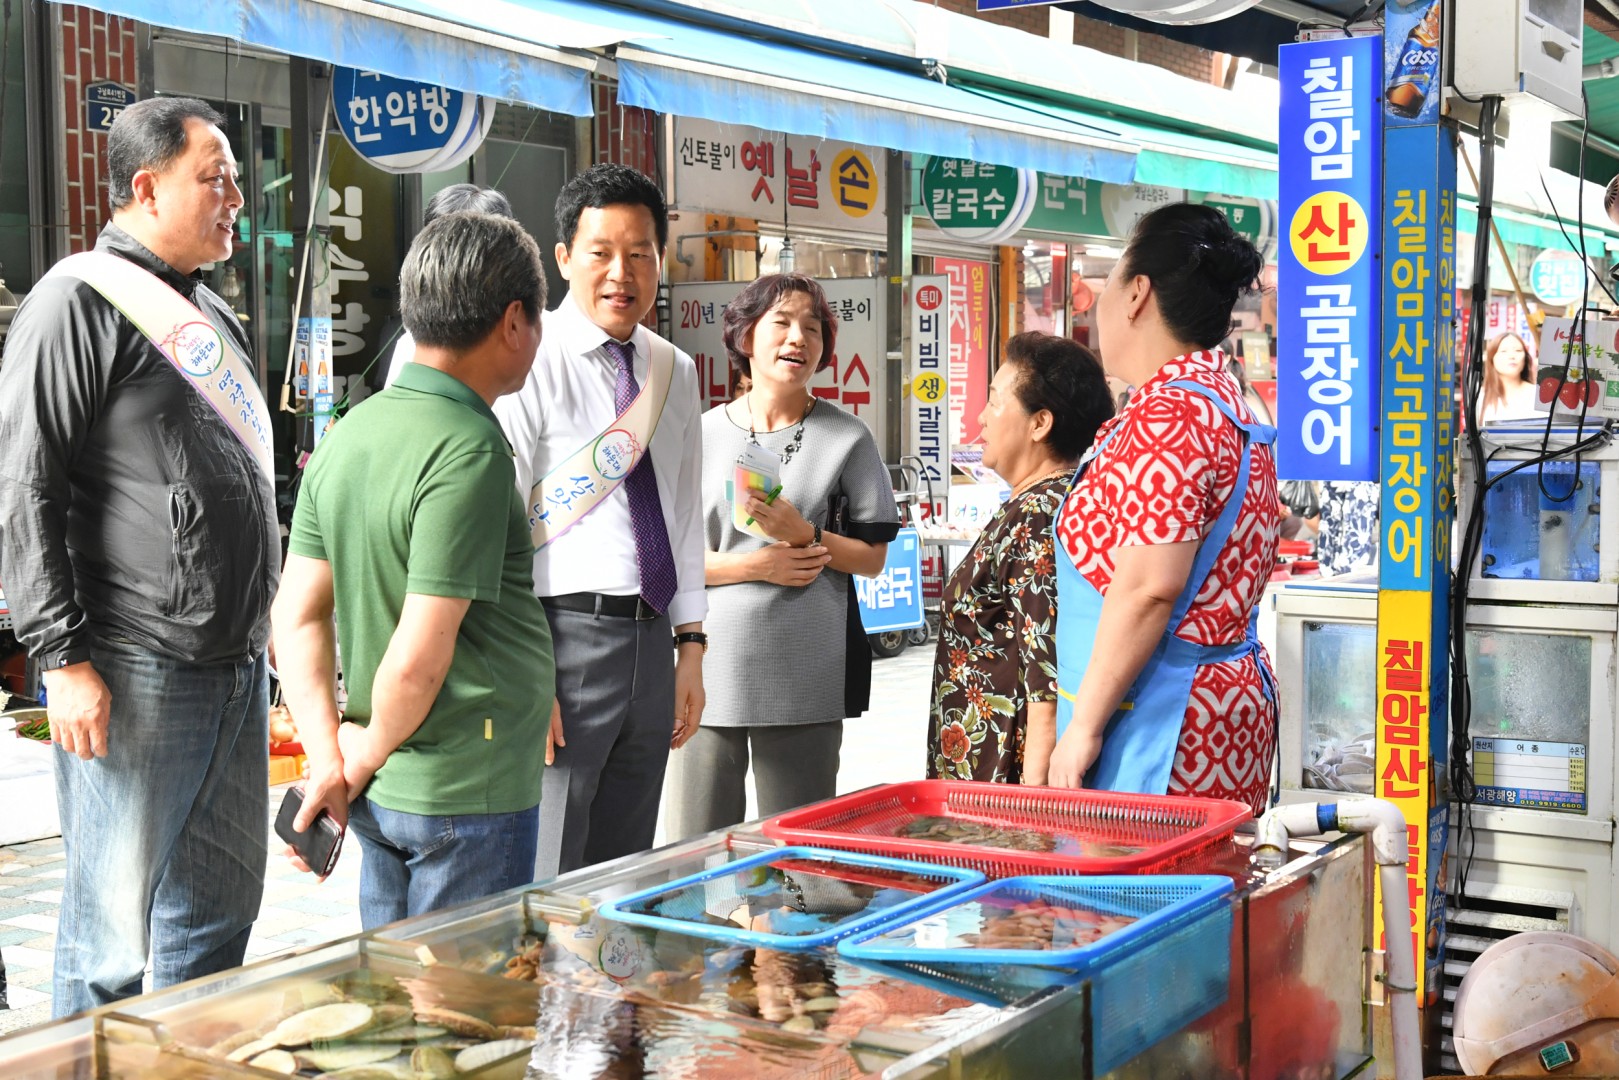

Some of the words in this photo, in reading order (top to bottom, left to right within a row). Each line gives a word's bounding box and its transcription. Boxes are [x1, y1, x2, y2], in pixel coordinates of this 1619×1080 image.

[348, 86, 451, 144] 한약방
[1301, 55, 1361, 181] 칠암
[680, 137, 736, 171] 신토불이
[740, 141, 821, 209] 옛날
[839, 155, 870, 210] 손
[933, 188, 1006, 220] 칼국수
[1298, 202, 1356, 262] 산
[681, 300, 715, 329] 20년
[920, 290, 939, 307] 특미
[190, 341, 216, 367] 해운대
[919, 312, 939, 369] 비빔
[918, 377, 940, 400] 생
[1300, 284, 1359, 466] 곰장어
[1387, 189, 1431, 578] 칠암산곰장어
[1435, 189, 1454, 575] 칠암산곰장어
[602, 445, 622, 472] 해운대
[918, 406, 942, 482] 칼국수
[855, 566, 913, 610] 재첩국
[1381, 639, 1427, 799] 칠암산
[1475, 740, 1493, 750] 원산지
[1476, 788, 1517, 803] 서광해양
